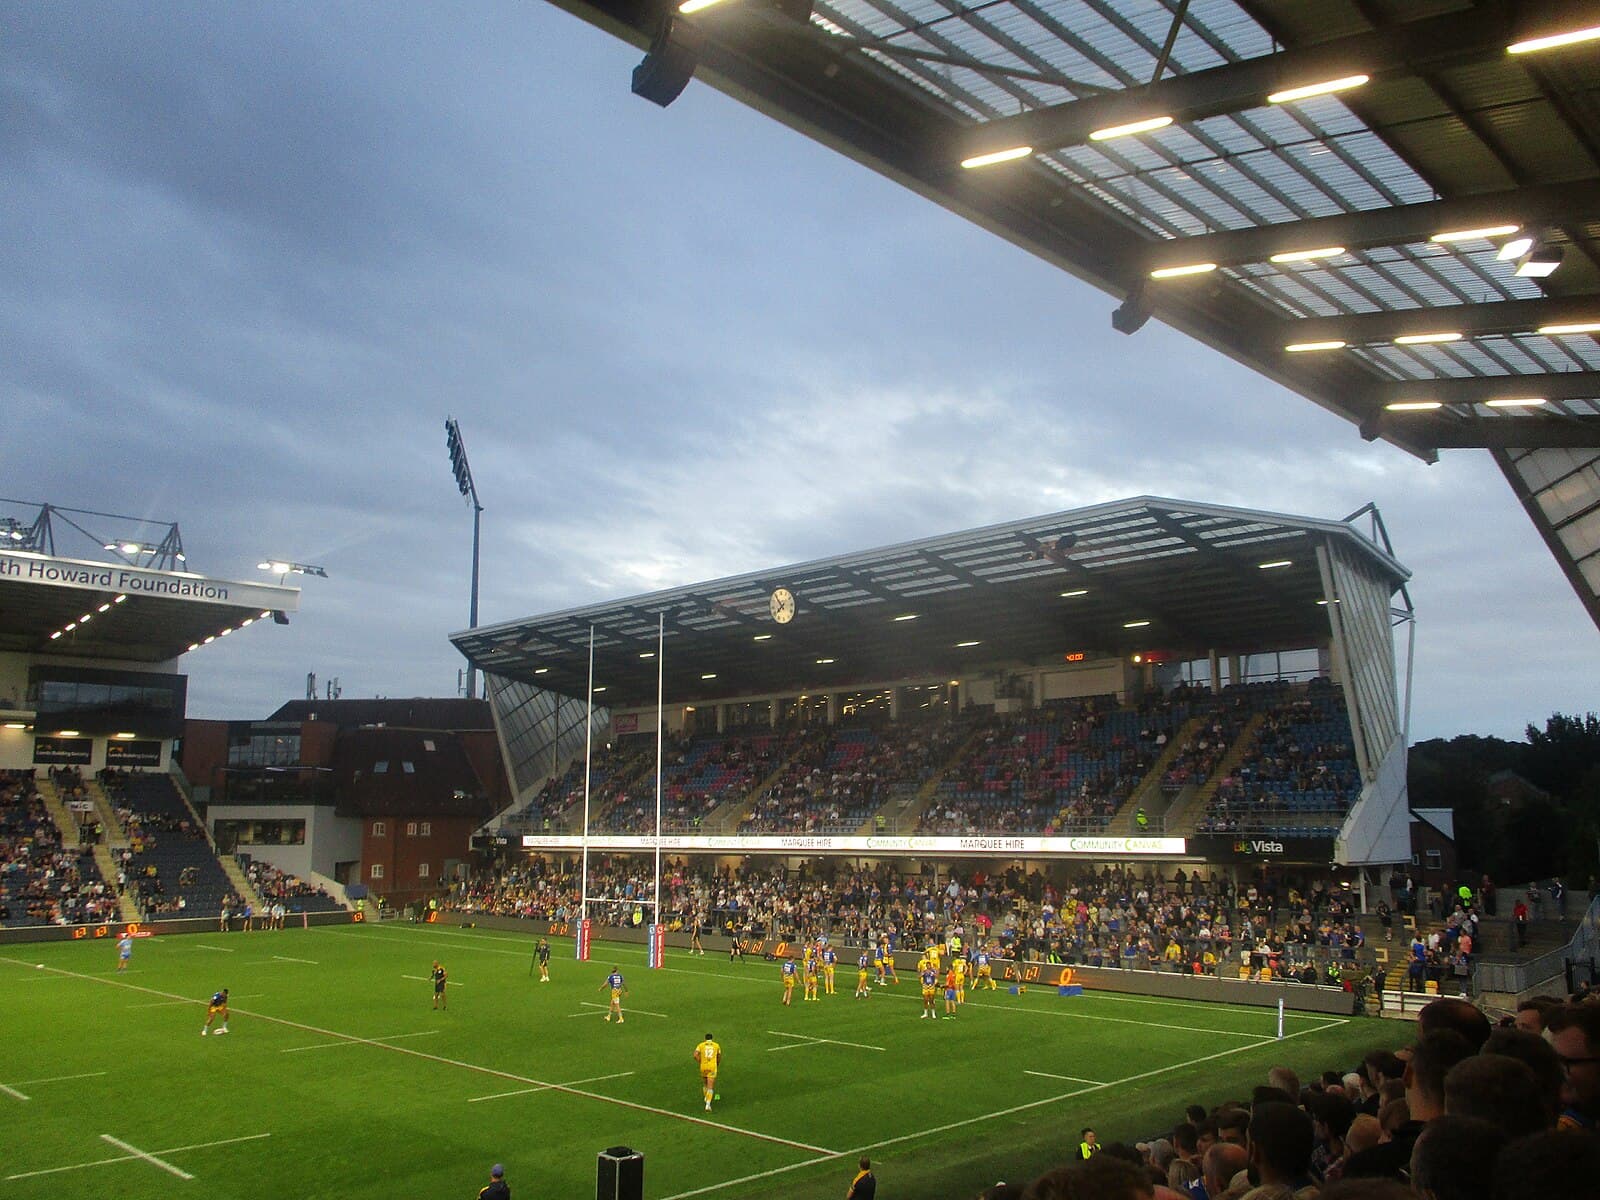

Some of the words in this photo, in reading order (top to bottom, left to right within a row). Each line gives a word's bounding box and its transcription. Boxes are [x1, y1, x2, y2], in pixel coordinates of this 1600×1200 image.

[29, 562, 112, 587] Howard
[119, 572, 228, 600] Foundation
[781, 838, 814, 847] MARQUEE
[816, 838, 832, 847] HIRE
[960, 839, 1003, 848] MARQUEE
[1005, 839, 1025, 849] HIRE
[1070, 838, 1123, 850] COMMUNITY
